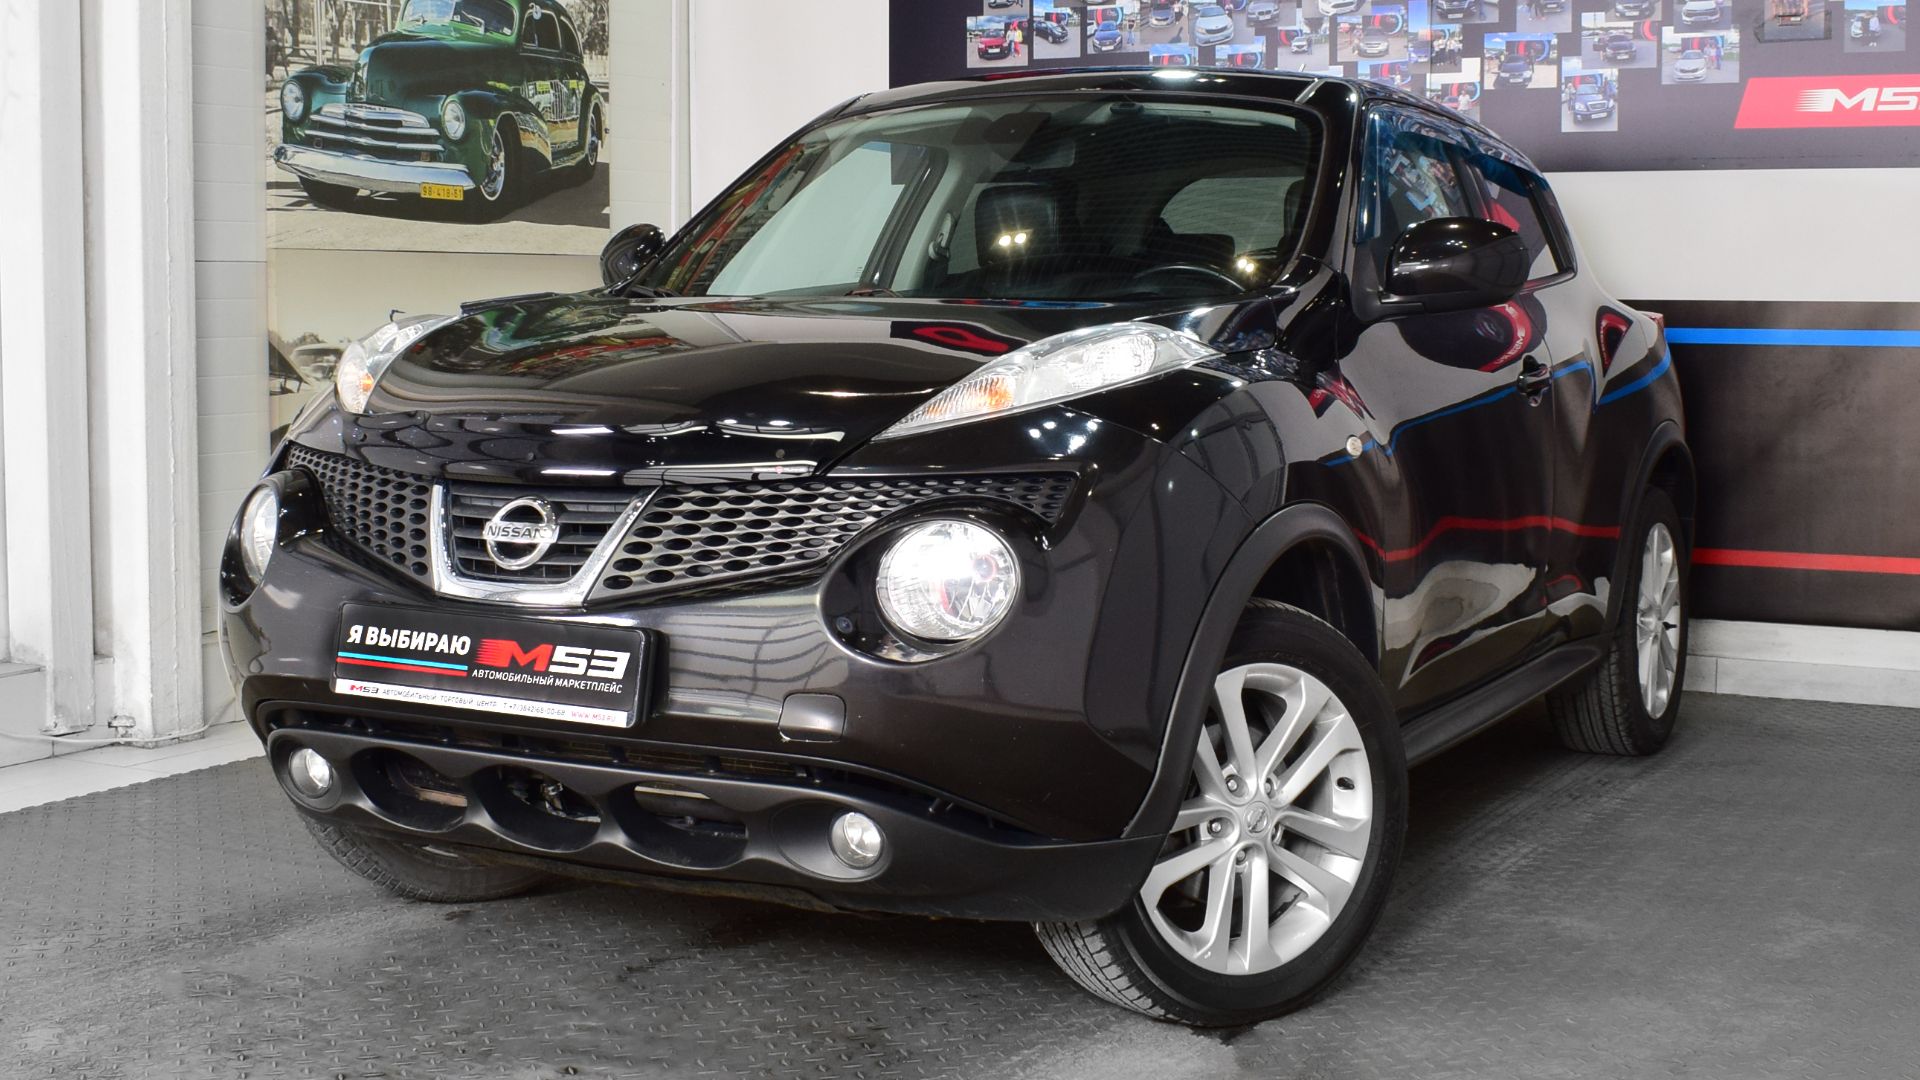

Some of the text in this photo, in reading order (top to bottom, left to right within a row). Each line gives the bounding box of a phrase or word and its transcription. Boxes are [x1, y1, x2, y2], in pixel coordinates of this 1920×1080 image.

[1794, 86, 1920, 112] M5
[347, 624, 364, 644] Я
[365, 626, 471, 656] ВЫБИРАЮ
[472, 669, 623, 694] АВТОМОБИЛЬНЫЙ МАРКЕТПЛЕЙС
